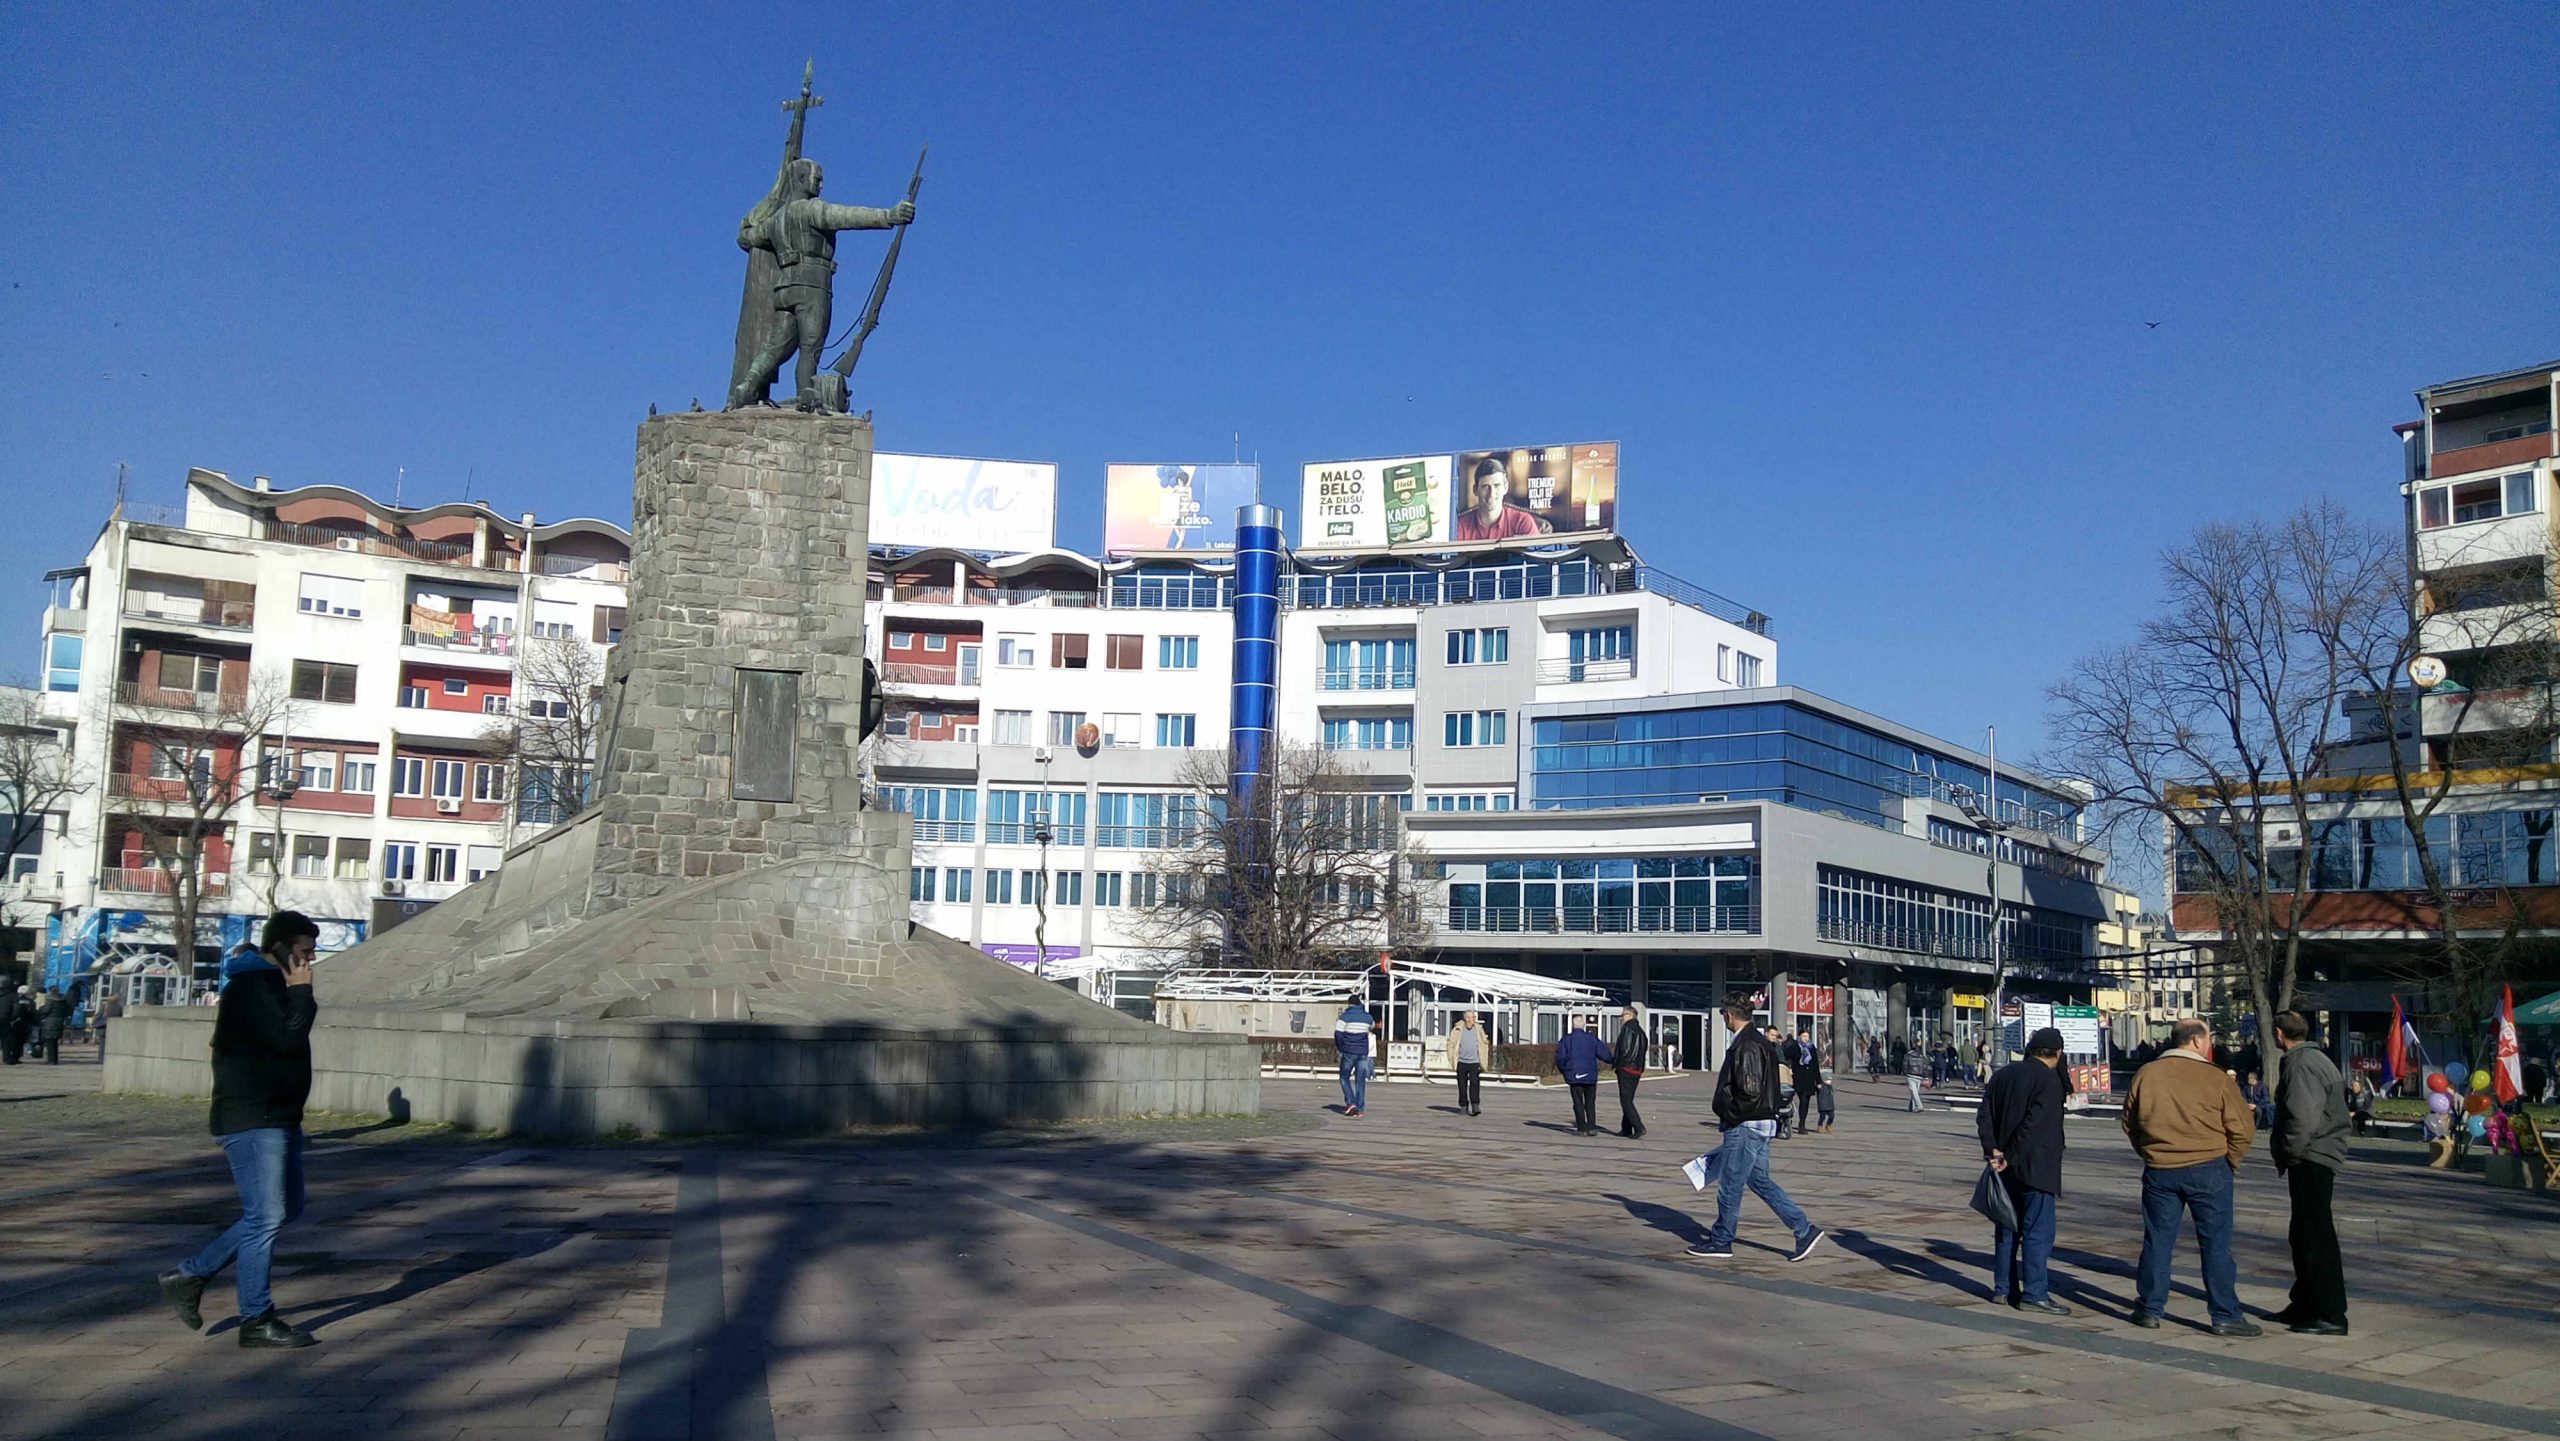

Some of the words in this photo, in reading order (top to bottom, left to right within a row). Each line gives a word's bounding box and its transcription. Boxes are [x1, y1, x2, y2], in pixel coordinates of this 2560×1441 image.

[1320, 469, 1365, 482] MALO,
[878, 458, 1014, 516] Voda
[1320, 482, 1365, 495] BELO,
[1527, 477, 1556, 489] TRENUCI
[1528, 488, 1544, 499] KOJI
[1545, 487, 1554, 498] SE
[1320, 496, 1333, 505] ZA
[1529, 498, 1552, 509] PAMTE
[1319, 505, 1323, 516] I
[1326, 504, 1364, 516] TELO.
[1387, 504, 1427, 524] KARDIO
